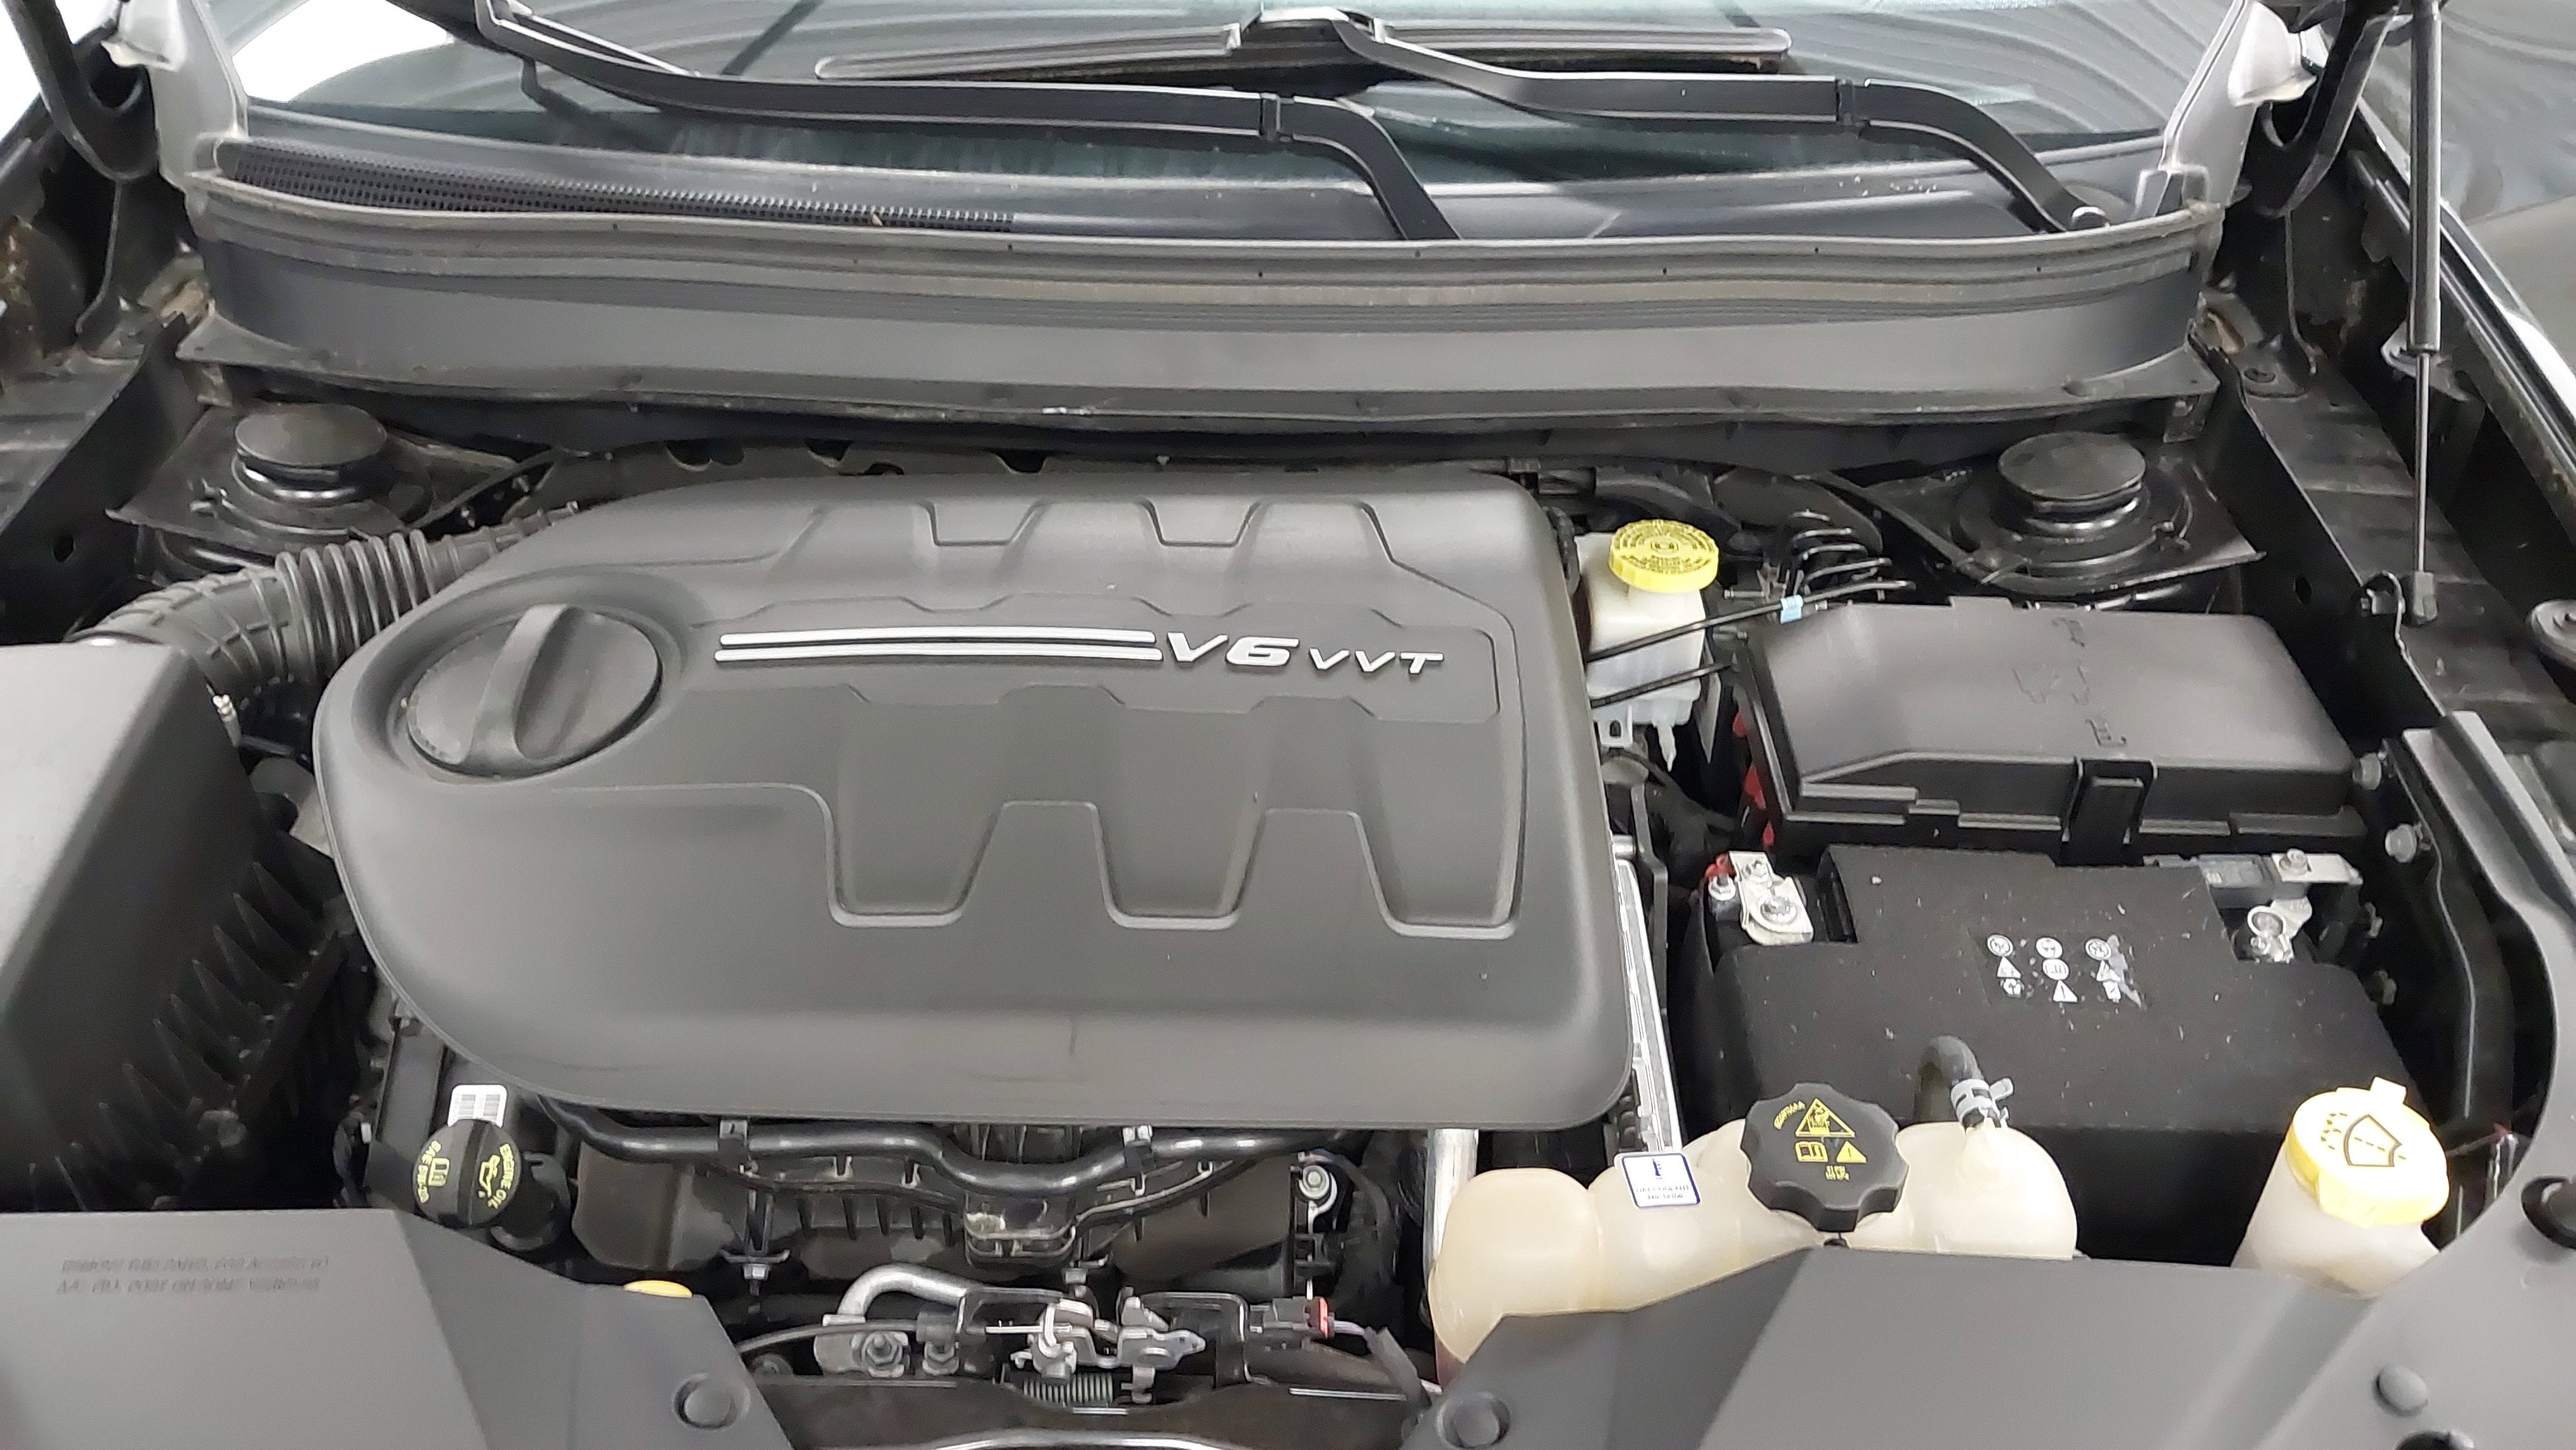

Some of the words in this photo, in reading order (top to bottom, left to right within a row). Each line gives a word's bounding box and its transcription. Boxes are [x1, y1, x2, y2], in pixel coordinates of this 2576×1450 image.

[1167, 631, 1301, 668] V6
[1308, 647, 1445, 674] VVT
[487, 1189, 507, 1209] OIL
